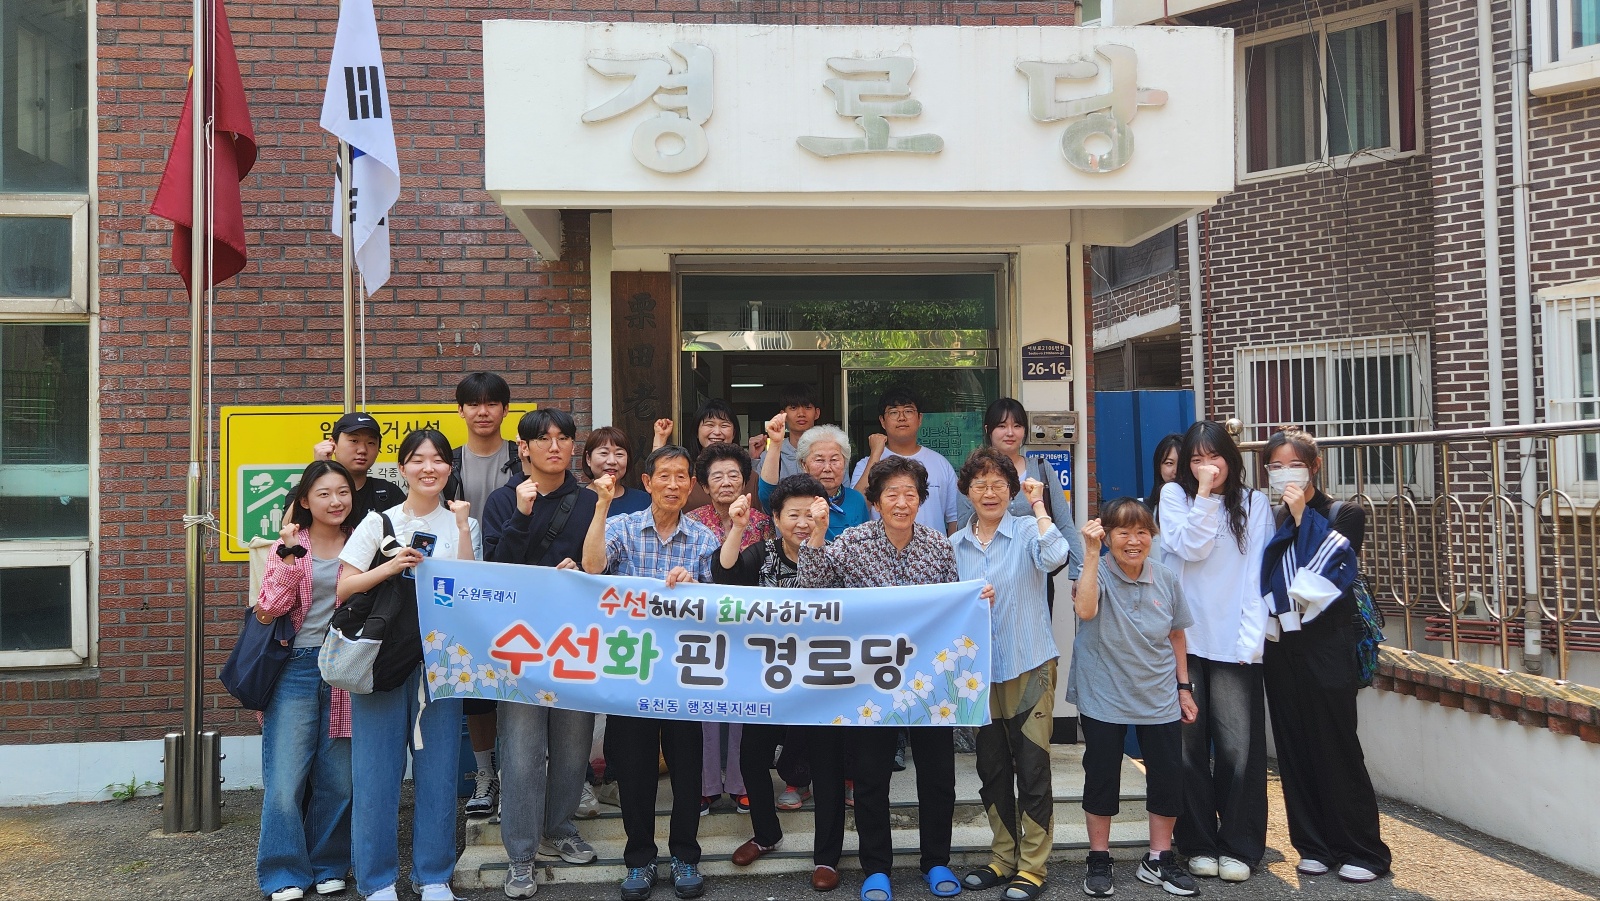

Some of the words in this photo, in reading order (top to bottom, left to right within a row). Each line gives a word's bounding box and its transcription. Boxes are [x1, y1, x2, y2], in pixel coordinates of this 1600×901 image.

[580, 42, 1169, 173] 경로당
[621, 291, 660, 440] 栗田老
[1027, 362, 1066, 375] 26-16
[378, 467, 399, 478] 각종
[457, 587, 517, 604] 수원특례시
[599, 586, 705, 621] 수선해서
[718, 596, 841, 623] 화사하게
[490, 623, 659, 681] 수선화
[675, 633, 726, 686] 핀
[747, 633, 914, 691] 경로당
[637, 698, 679, 713] 율천동
[687, 699, 772, 716] 행정복지센터
